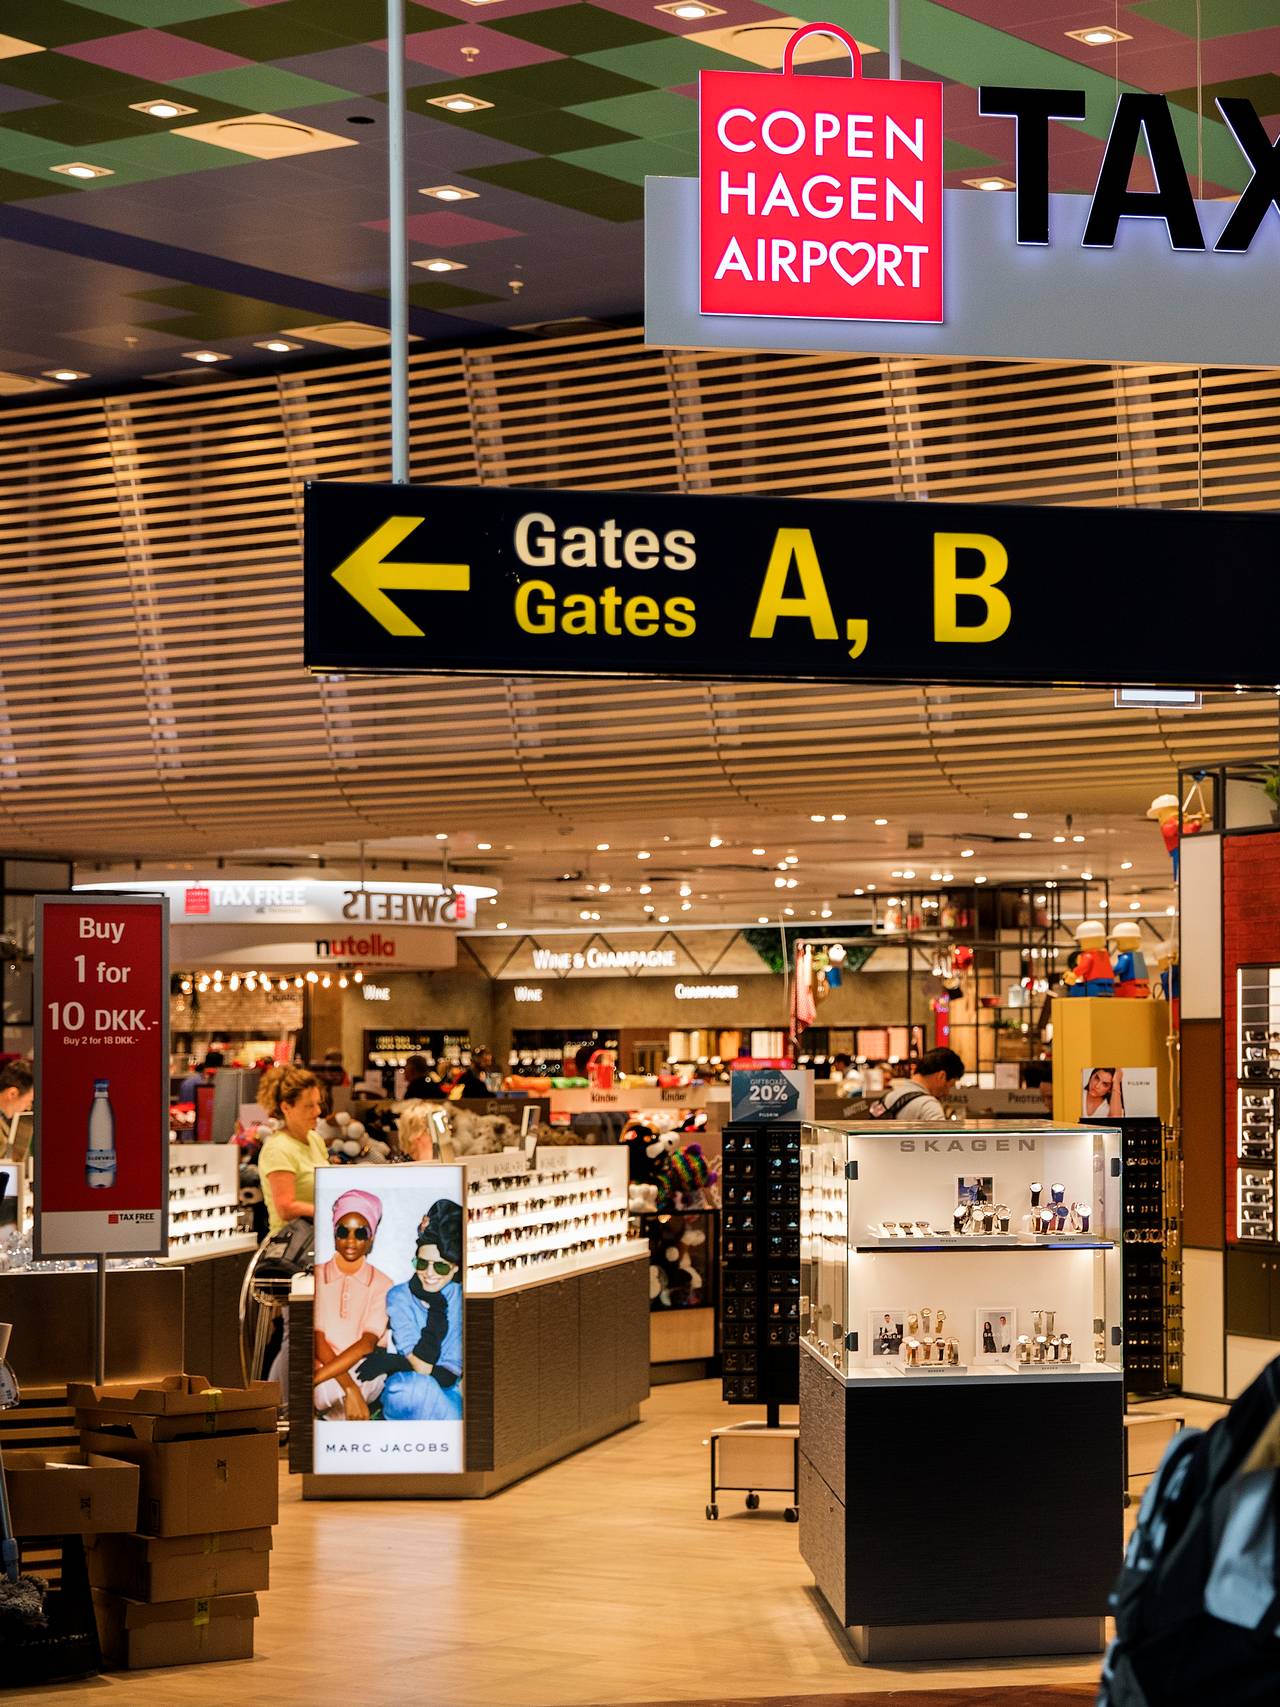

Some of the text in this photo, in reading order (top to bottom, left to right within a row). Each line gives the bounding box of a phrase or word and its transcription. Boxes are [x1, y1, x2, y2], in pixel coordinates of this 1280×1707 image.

[717, 107, 924, 161] COPEN
[719, 171, 924, 224] HAGEN
[513, 511, 697, 571] Gates
[750, 527, 1012, 660] A, B
[513, 579, 698, 638] Gates
[213, 886, 251, 906] TAX
[254, 886, 306, 906] FREE
[79, 917, 125, 944] Buy
[315, 933, 396, 958] nutella
[74, 954, 131, 983] 1 for
[533, 949, 571, 969] WINE
[586, 948, 676, 968] CHAMPAGNE
[362, 984, 391, 1001] WINE
[514, 985, 543, 1002] WINE
[48, 1001, 159, 1031] 10 DKK.-
[63, 1036, 80, 1047] Buy
[81, 1036, 88, 1045] 2
[89, 1036, 101, 1045] for
[103, 1036, 114, 1045] 18
[749, 1085, 789, 1101] 20%
[899, 1138, 1037, 1153] SKAGEN
[119, 1213, 134, 1221] TAX
[325, 1442, 450, 1454] MARC JACOBS
